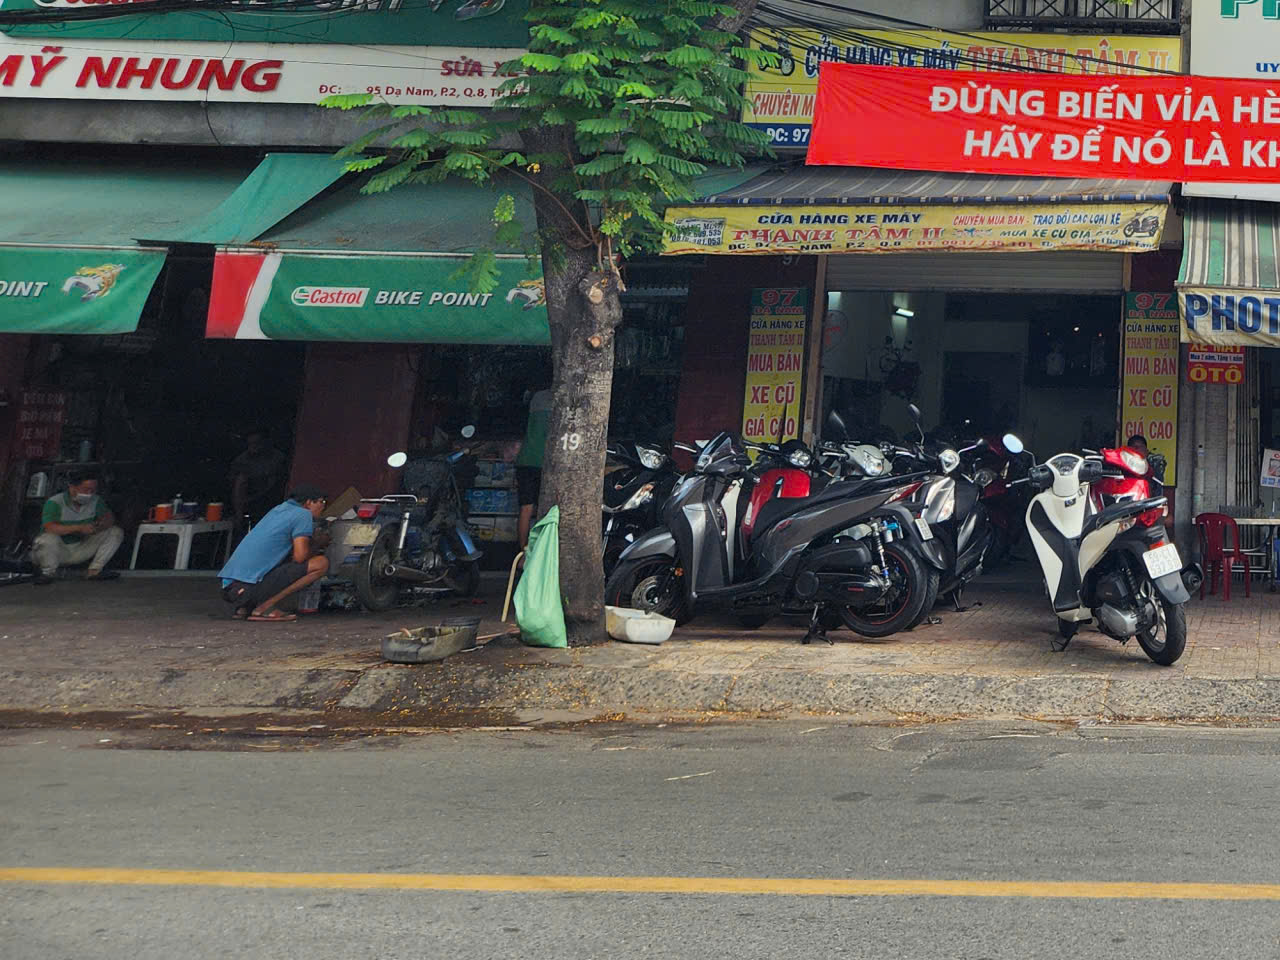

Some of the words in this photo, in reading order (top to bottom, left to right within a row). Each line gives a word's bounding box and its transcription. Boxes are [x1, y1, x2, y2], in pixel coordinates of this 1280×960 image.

[75, 56, 284, 93] NHUNG
[440, 55, 483, 77] SỬA
[1256, 62, 1280, 73] UY
[366, 85, 380, 95] 95
[385, 86, 403, 98] Dạ
[406, 86, 437, 97] Nam,
[752, 88, 800, 117] CHUYÊN
[929, 80, 1045, 117] ĐỪNG
[1057, 84, 1143, 120] BIẾN
[1155, 87, 1219, 123] VỈA
[1233, 90, 1280, 125] HÈ
[792, 128, 810, 143] 97
[963, 124, 1042, 159] HÃY
[1051, 125, 1104, 162] ĐỂ
[1112, 130, 1171, 164] NÓ
[1184, 132, 1229, 167] LÀ
[758, 211, 793, 225] CỬA
[799, 212, 849, 225] HÀNG
[855, 214, 877, 225] XE
[882, 211, 921, 224] MÁY
[953, 213, 984, 226] CHUYÊN
[987, 214, 1006, 226] MUA
[1007, 213, 1025, 225] BÁN
[1110, 212, 1121, 225] XE
[732, 229, 837, 244] THANH
[846, 226, 914, 240] TÂM
[1031, 229, 1049, 238] XE
[800, 242, 832, 251] NAM
[308, 287, 364, 307] Castrol
[375, 291, 422, 306] BIKE
[428, 291, 493, 308] POINT
[761, 289, 797, 306] 97
[1135, 293, 1170, 309] 97
[1151, 310, 1177, 318] NAM
[794, 320, 805, 329] XE
[1169, 324, 1178, 332] XE
[748, 353, 773, 372] MUA
[777, 350, 801, 372] BÁN
[1126, 356, 1149, 376] MUA
[1153, 352, 1177, 376] BÁN
[1190, 363, 1242, 382] ÔTÔ
[751, 385, 770, 404] XE
[775, 382, 795, 404] CŨ
[1129, 389, 1147, 406] XE
[1152, 385, 1172, 407] CŨ
[745, 415, 765, 437] GIÁ
[1125, 416, 1144, 438] GIÁ
[1149, 421, 1173, 440] CAO
[561, 433, 580, 450] 19
